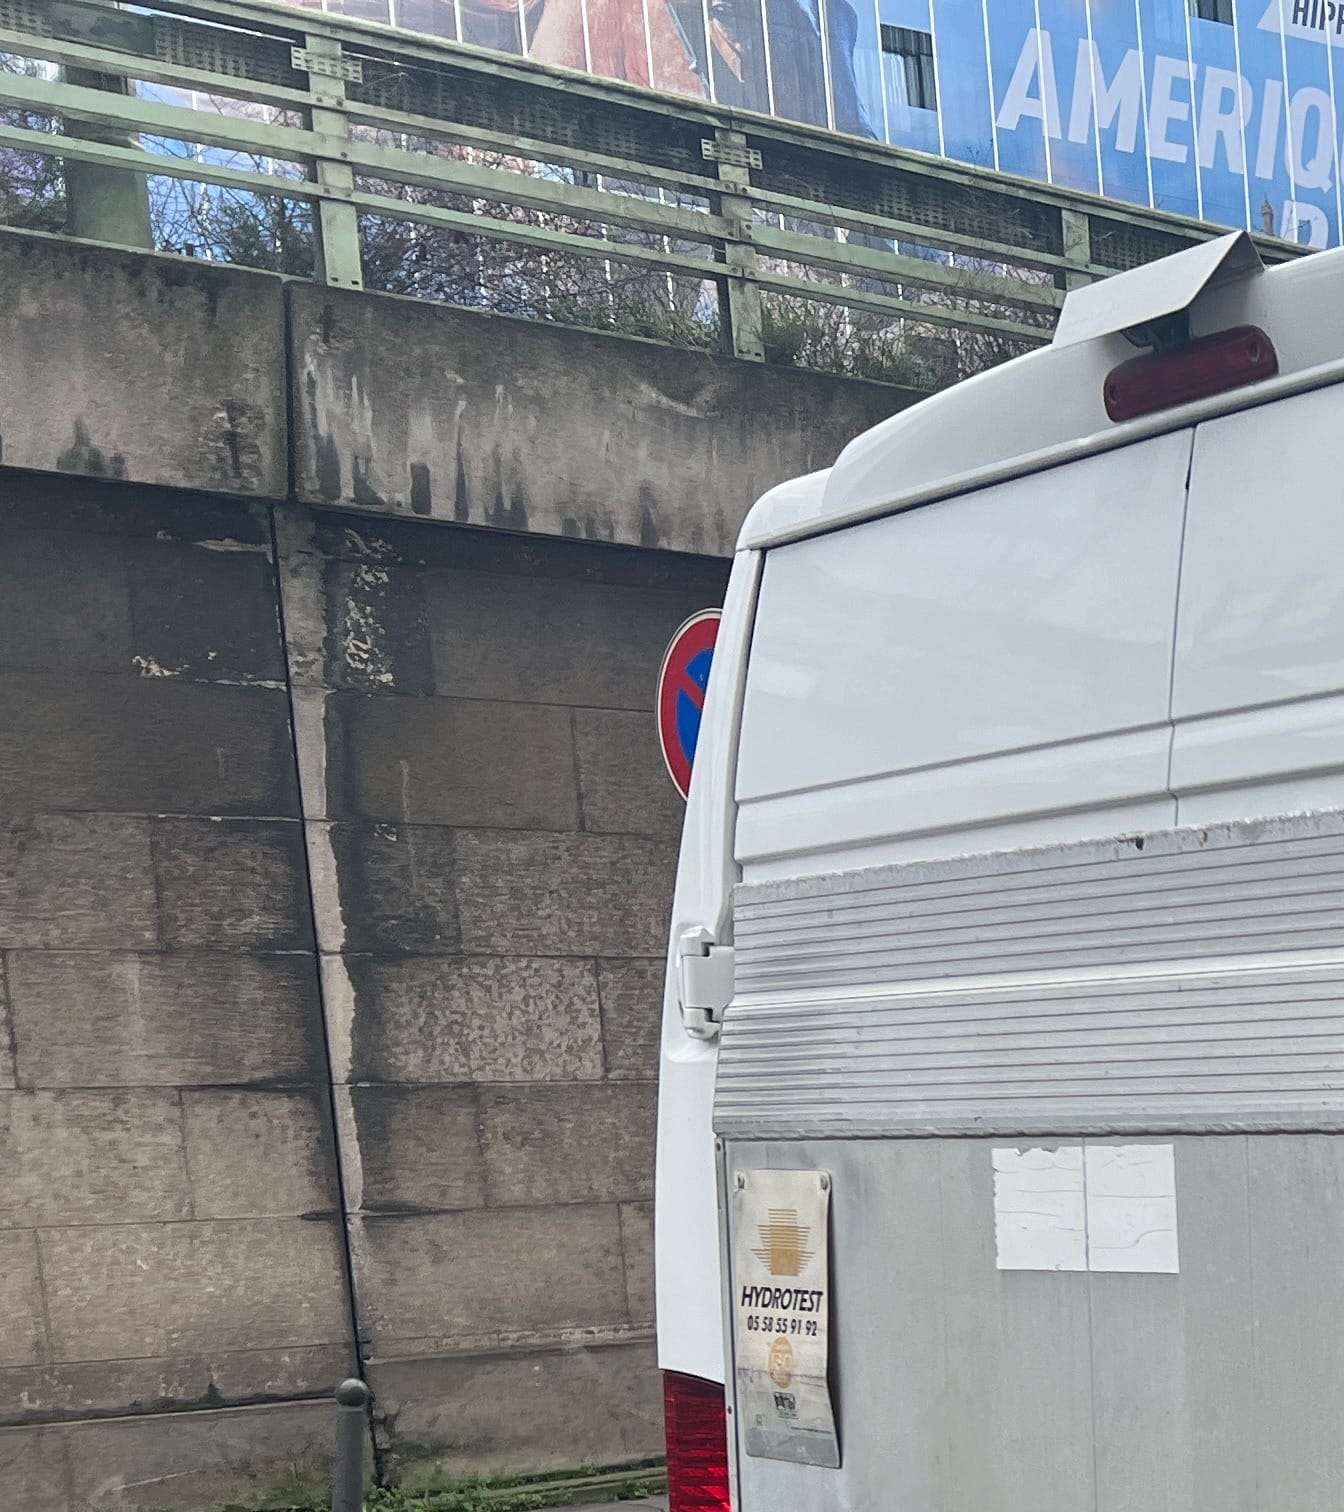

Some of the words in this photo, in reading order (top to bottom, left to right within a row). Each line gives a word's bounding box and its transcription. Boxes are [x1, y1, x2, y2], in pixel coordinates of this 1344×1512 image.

[741, 1285, 824, 1313] HYDROTEST
[747, 1315, 760, 1332] 05
[761, 1316, 773, 1333] 58
[775, 1317, 788, 1334] 55
[790, 1318, 802, 1335] 91
[805, 1320, 818, 1337] 92
